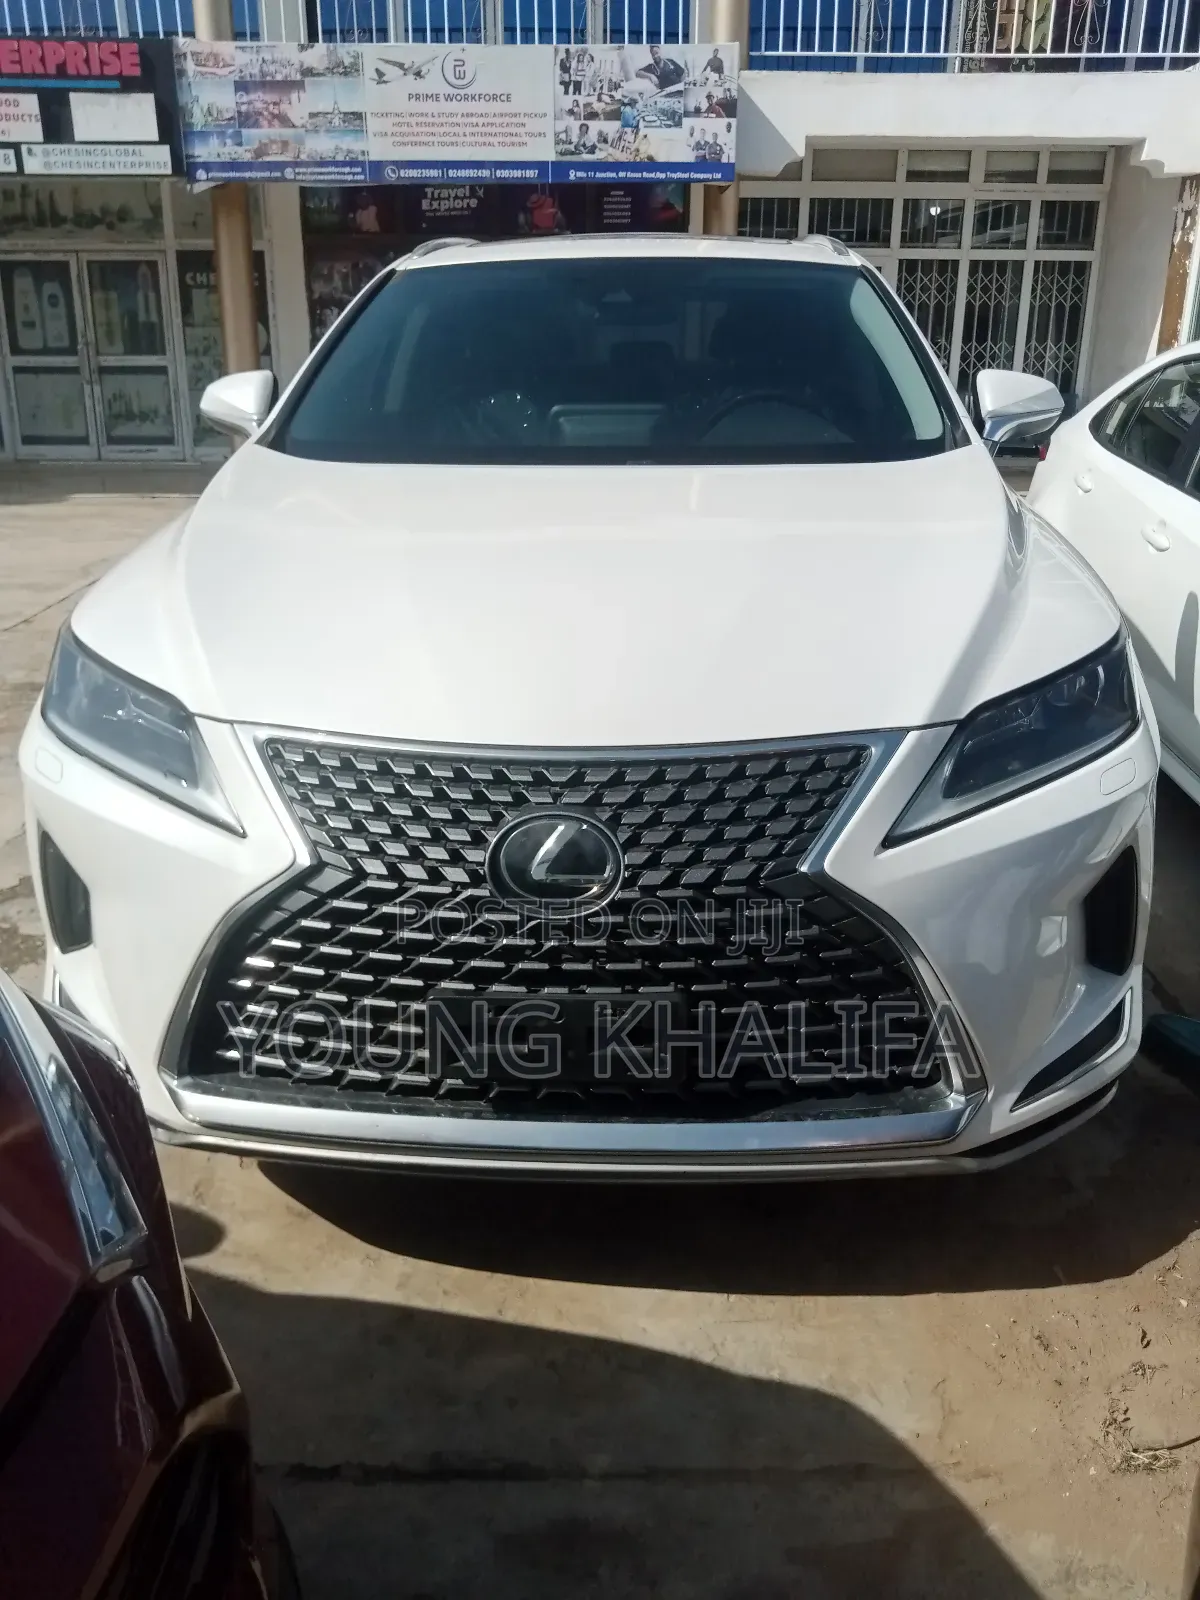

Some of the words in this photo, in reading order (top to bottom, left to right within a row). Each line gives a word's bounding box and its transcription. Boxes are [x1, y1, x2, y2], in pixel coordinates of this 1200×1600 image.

[408, 93, 440, 102] PRIME
[444, 93, 512, 102] WORKFORCE
[425, 186, 470, 199] Travel
[422, 198, 478, 212] Explore
